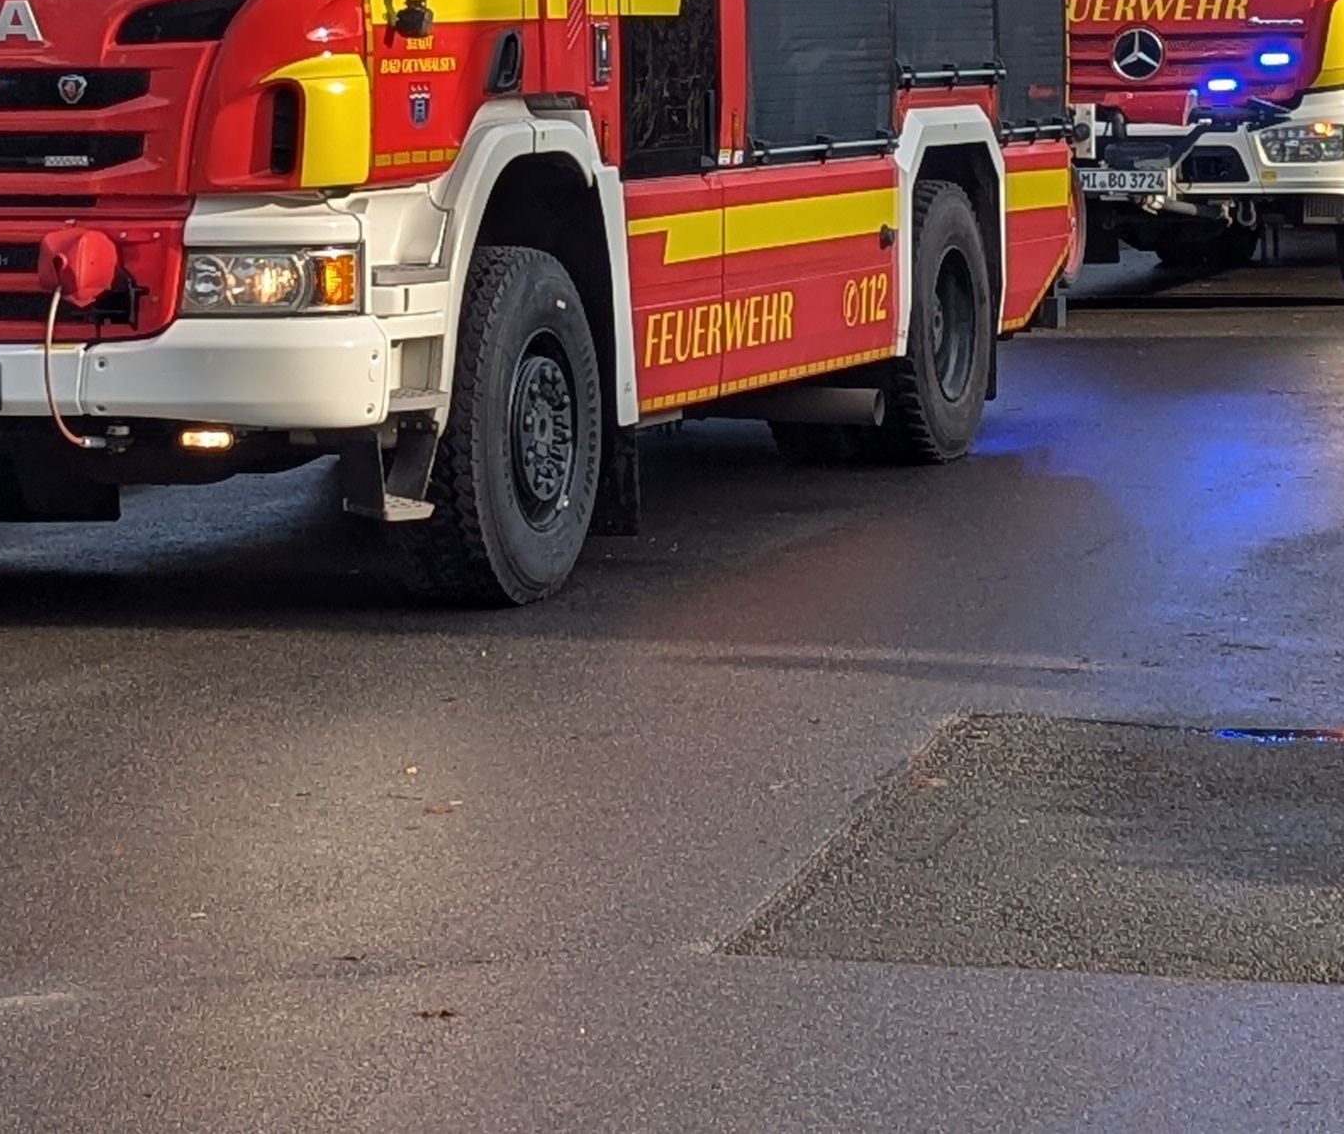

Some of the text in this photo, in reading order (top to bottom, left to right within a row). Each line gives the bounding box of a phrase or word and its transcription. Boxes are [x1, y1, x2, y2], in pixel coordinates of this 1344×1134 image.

[1129, 172, 1165, 190] 3724
[859, 272, 889, 326] 112
[643, 291, 795, 369] FEUERWEHR
